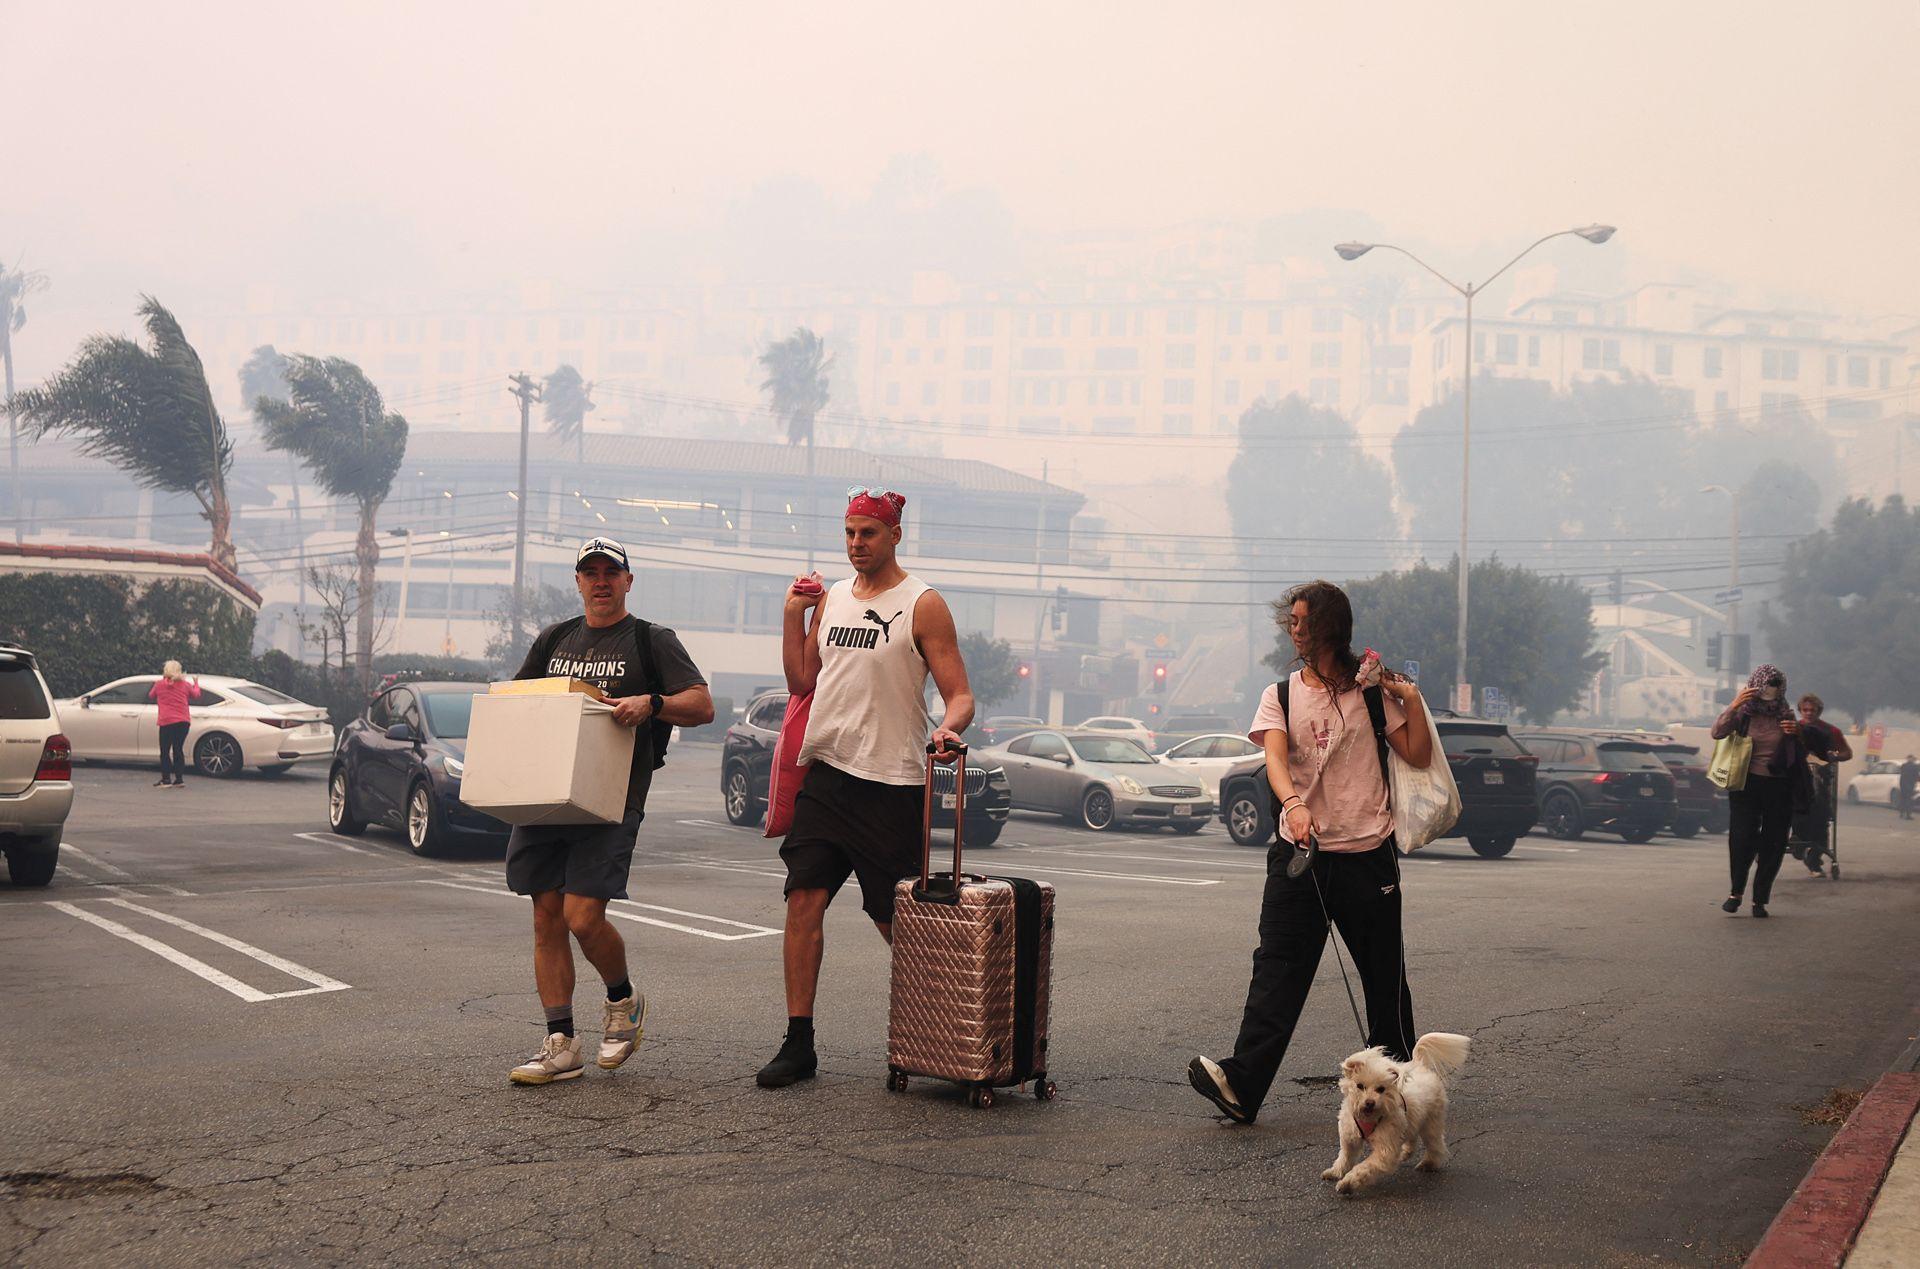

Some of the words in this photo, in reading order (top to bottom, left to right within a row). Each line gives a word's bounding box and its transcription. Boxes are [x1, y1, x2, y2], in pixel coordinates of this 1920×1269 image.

[593, 540, 605, 550] LA
[826, 626, 880, 650] PUMA
[548, 658, 626, 678] CHAMPIONS
[597, 680, 608, 688] 20
